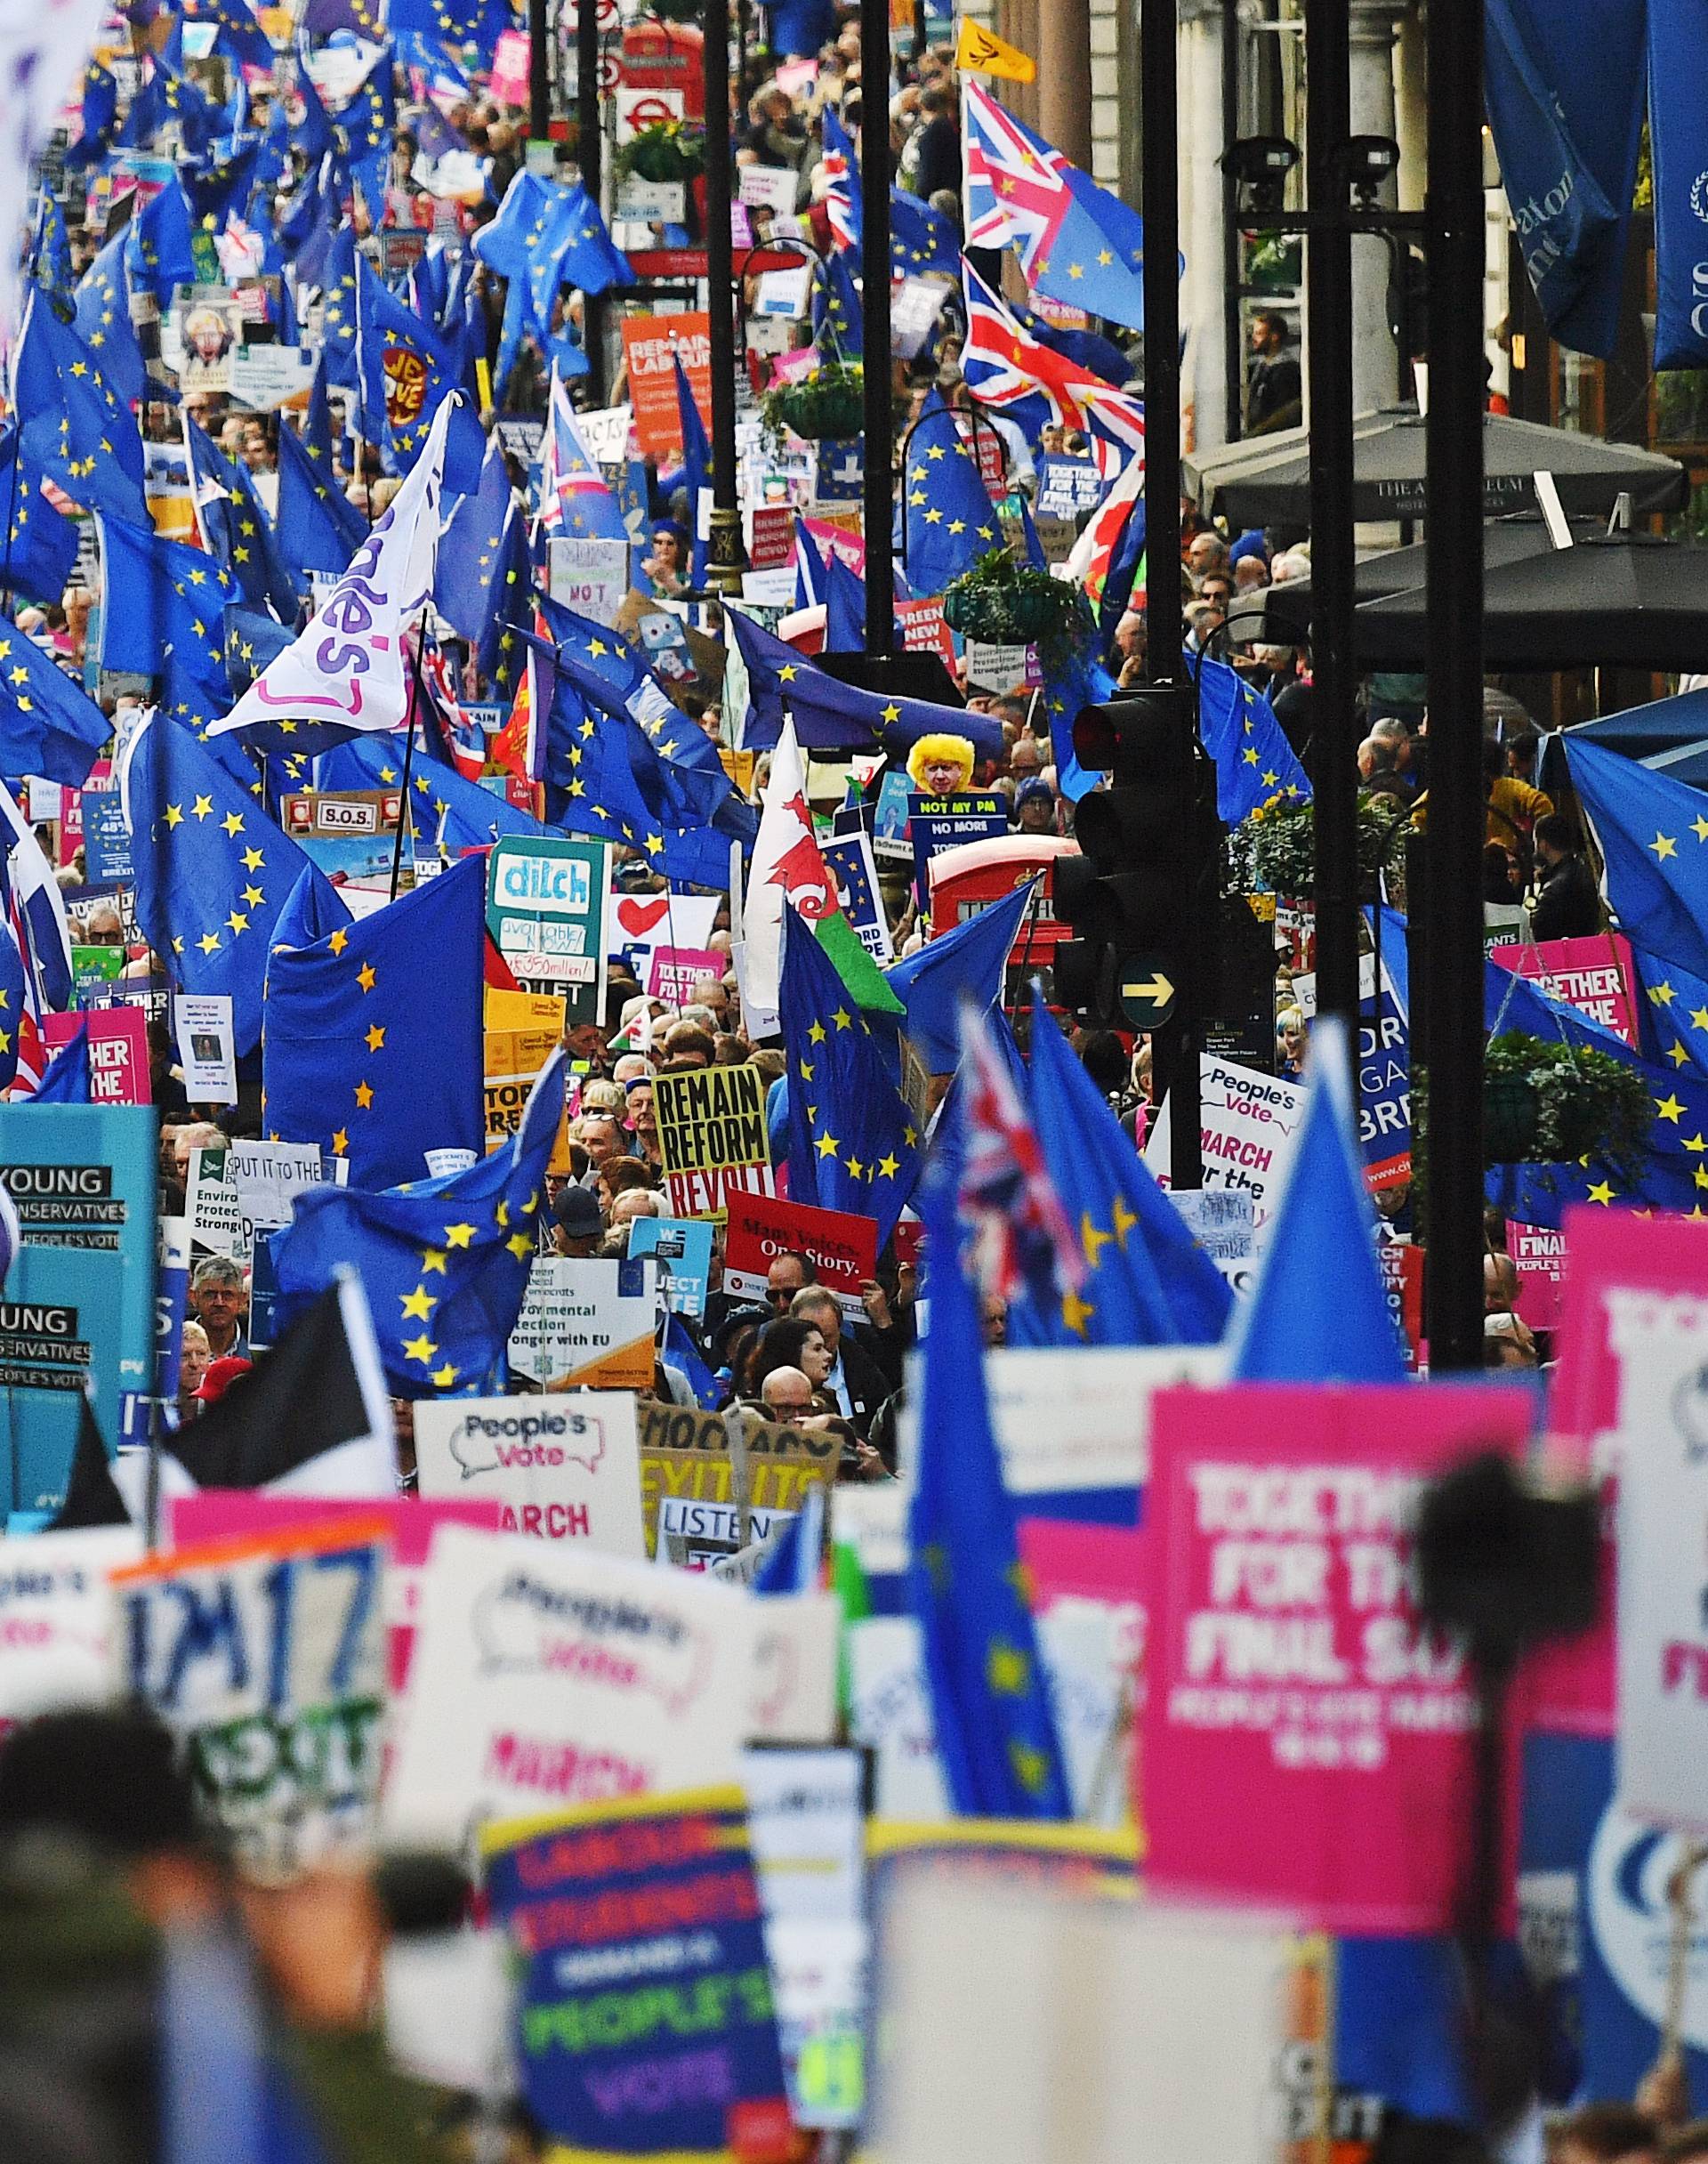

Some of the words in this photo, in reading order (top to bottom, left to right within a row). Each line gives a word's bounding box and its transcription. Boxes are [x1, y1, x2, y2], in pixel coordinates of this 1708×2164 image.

[1378, 480, 1410, 497] THE
[570, 575, 606, 602] NOT
[904, 624, 940, 642] NEW
[326, 808, 370, 825] S.O.S.
[920, 803, 948, 813] NOT
[953, 803, 971, 813] MY
[977, 801, 996, 812] PM
[932, 823, 952, 835] NO
[955, 820, 987, 833] MORE
[1527, 968, 1622, 1000] GETHER
[1575, 999, 1617, 1025] THE
[1211, 1068, 1295, 1110] People's
[1359, 1060, 1407, 1094] GA
[486, 1084, 532, 1110] TOP
[656, 1069, 759, 1126] REMAIN
[1226, 1093, 1272, 1123] Vote
[662, 1114, 765, 1171] REFORM
[1201, 1126, 1272, 1172] MARCH
[234, 1157, 258, 1177] PUT
[262, 1159, 274, 1178] IT
[276, 1162, 292, 1180] TO
[294, 1160, 321, 1182] THE
[197, 1189, 238, 1202] Enviro
[1225, 1168, 1264, 1200] the
[17, 1203, 128, 1221] NSERVATIVES
[196, 1204, 238, 1217] Protec
[1519, 1236, 1567, 1256] FINAL
[805, 1248, 860, 1276] Story.
[1515, 1260, 1559, 1271] PEOPLE'S
[657, 1274, 702, 1292] JECT
[655, 1292, 700, 1316] ATE
[515, 1320, 566, 1331] tection
[512, 1335, 553, 1348] onger
[557, 1334, 588, 1346] with
[592, 1335, 610, 1346] EU
[464, 1410, 587, 1445] People's
[495, 1441, 565, 1468] Vote
[1187, 1464, 1425, 1537] TOGETH
[500, 1505, 590, 1538] ARCH
[664, 1504, 770, 1540] LISTEN
